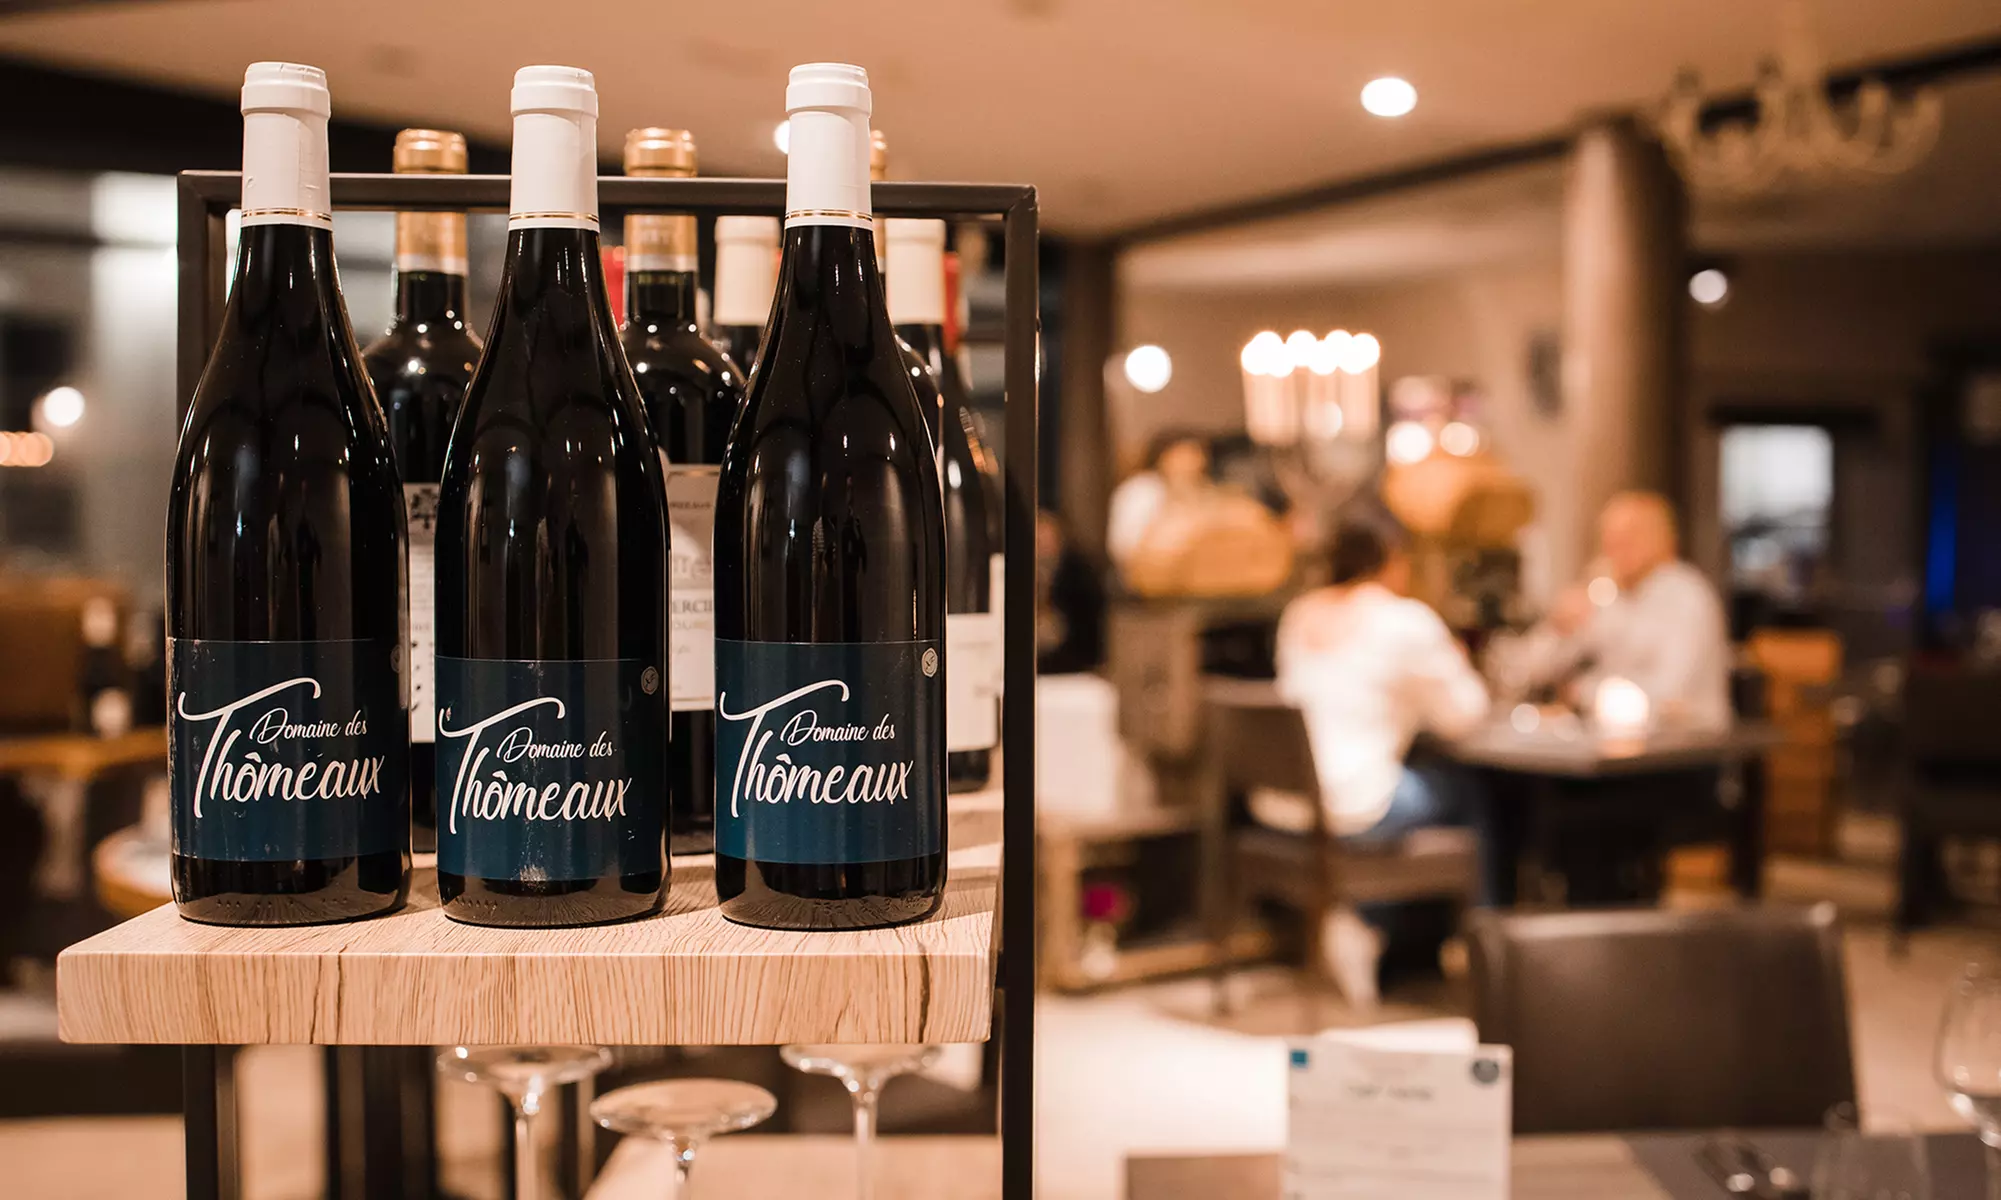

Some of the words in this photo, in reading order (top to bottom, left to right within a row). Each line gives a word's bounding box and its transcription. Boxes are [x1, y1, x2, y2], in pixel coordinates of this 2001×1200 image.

[249, 707, 341, 744] Domaine
[345, 709, 367, 737] des
[780, 709, 869, 746] Domaine
[872, 713, 896, 740] des
[496, 726, 586, 763] Domaine
[589, 731, 613, 757] des
[719, 679, 914, 818] Thômeaux
[438, 697, 632, 834] Thômeaux
